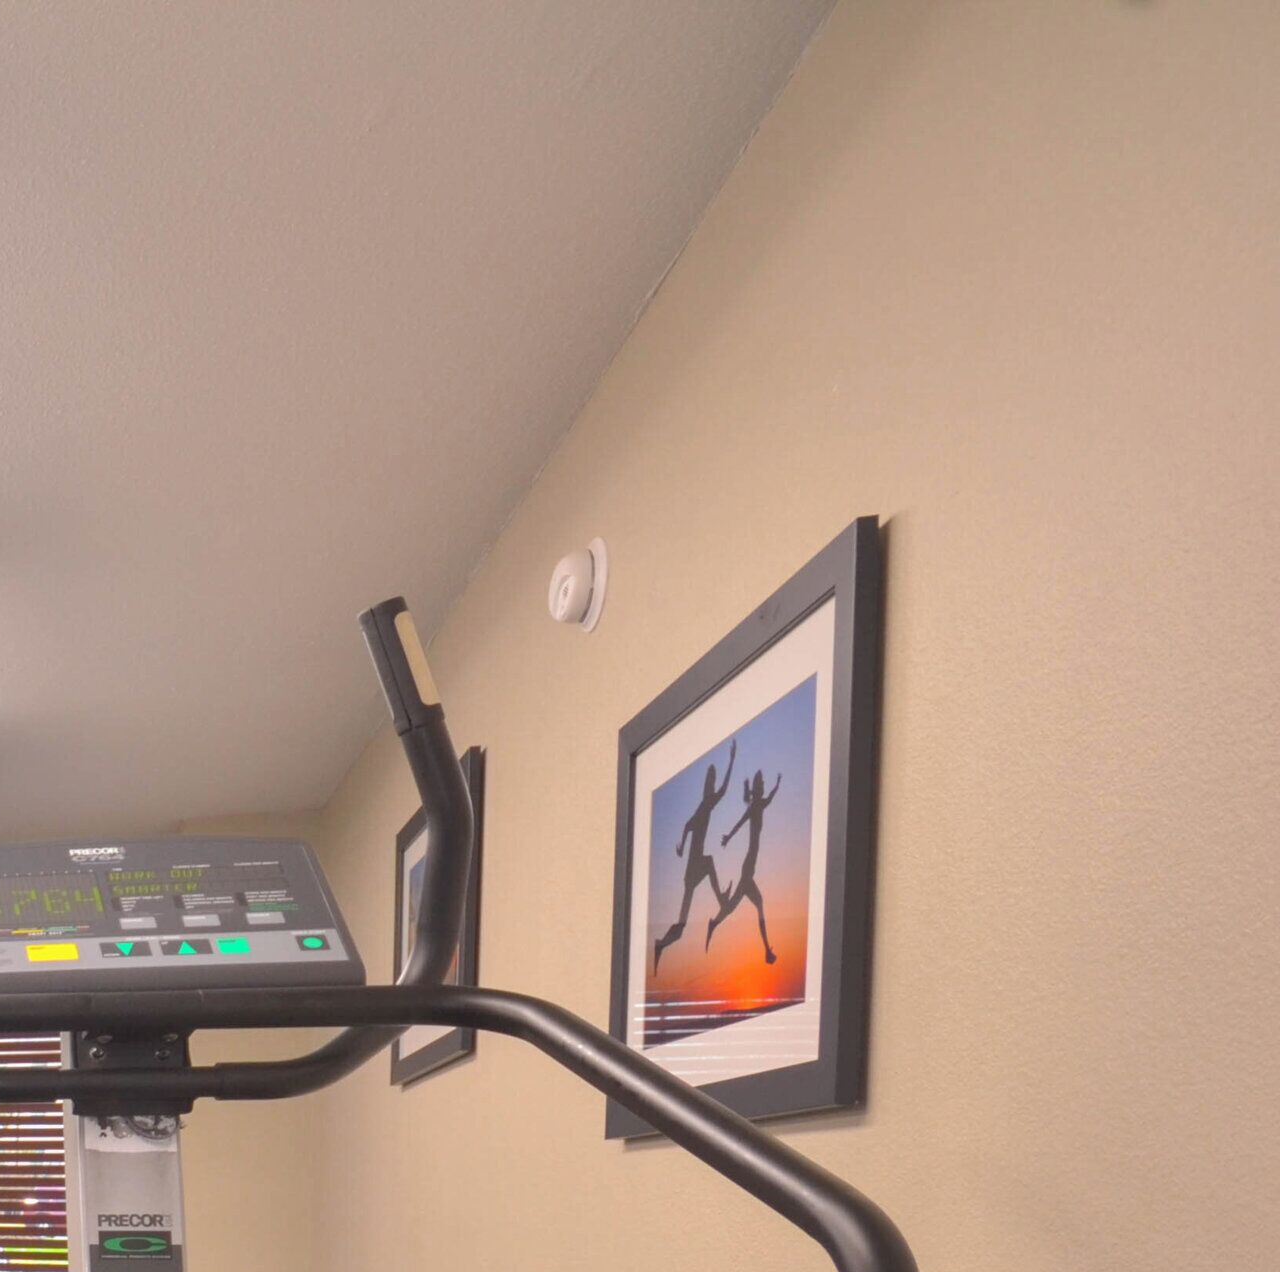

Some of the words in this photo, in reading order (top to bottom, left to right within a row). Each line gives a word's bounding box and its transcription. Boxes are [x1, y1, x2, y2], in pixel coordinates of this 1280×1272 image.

[69, 848, 119, 856] PRECOR
[170, 868, 203, 879] OUT
[98, 1213, 164, 1228] PRECOR
